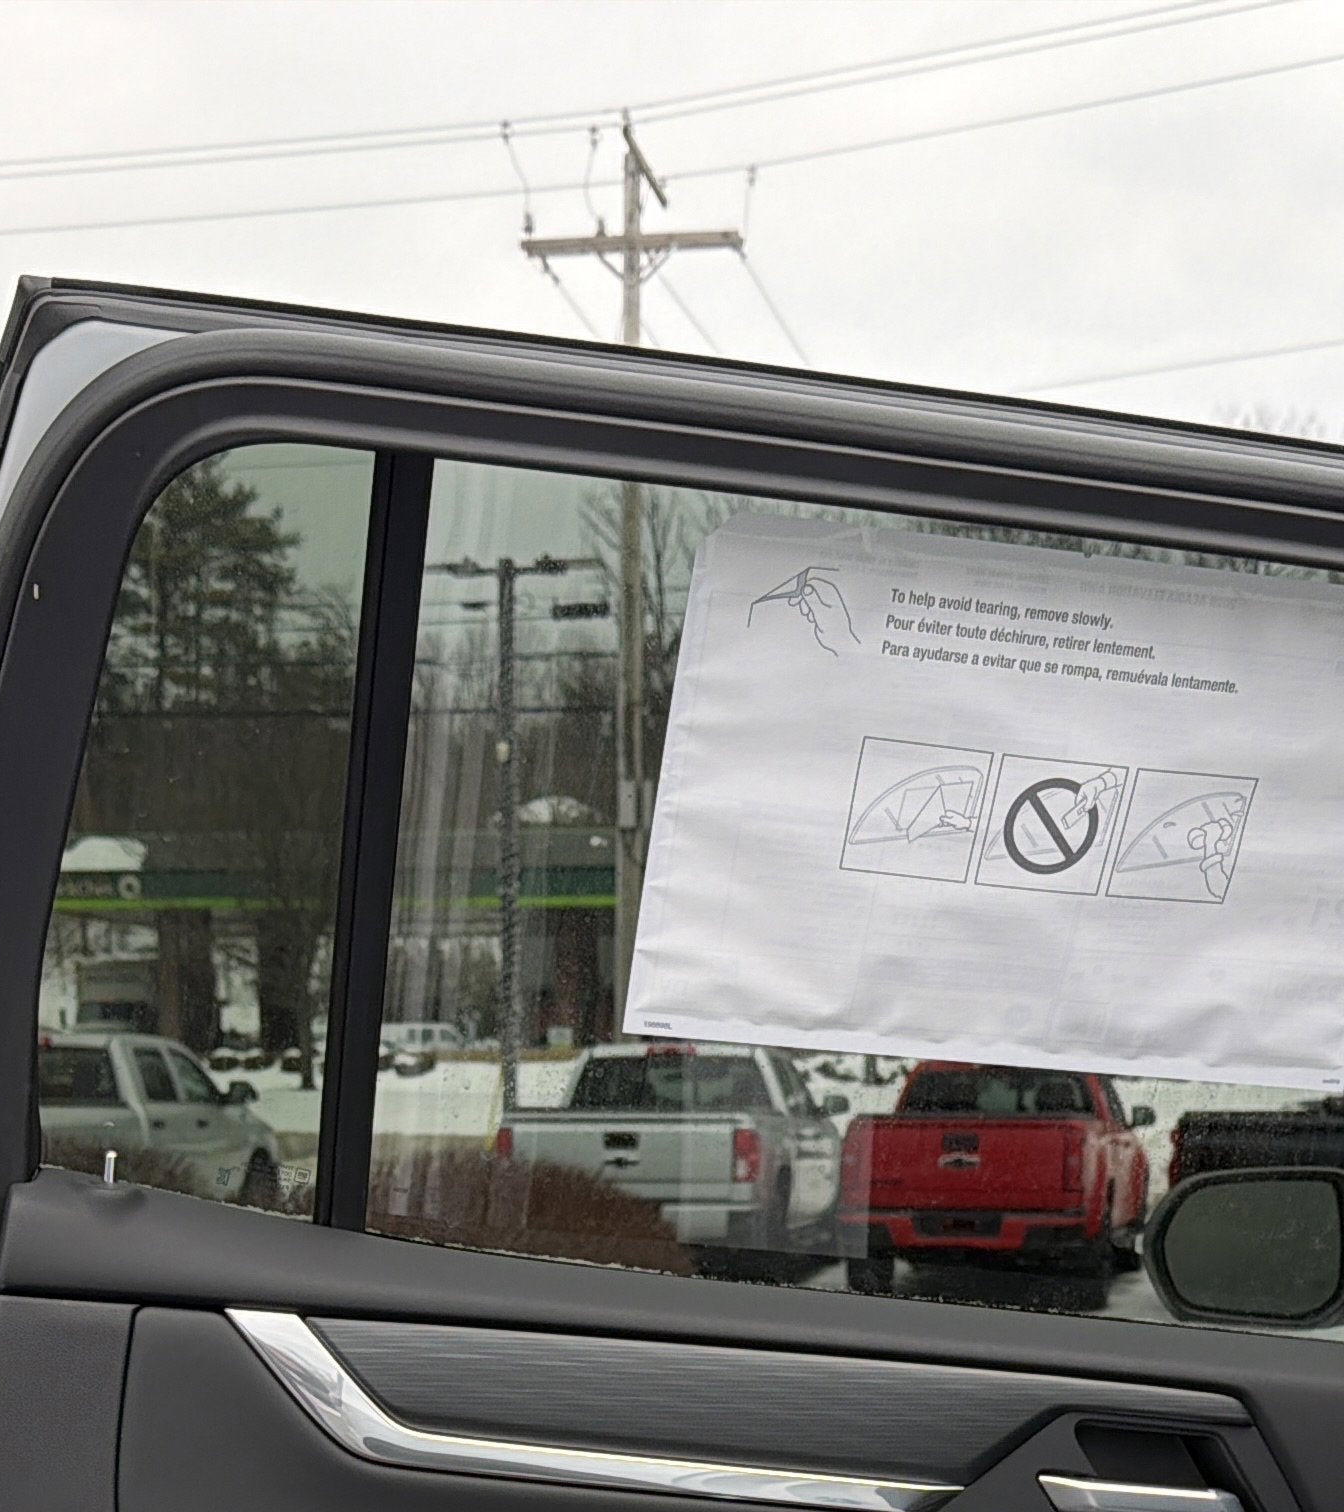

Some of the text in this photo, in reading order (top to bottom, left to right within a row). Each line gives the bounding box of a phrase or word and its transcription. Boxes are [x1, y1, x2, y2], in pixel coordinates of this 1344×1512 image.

[891, 588, 1114, 630] To help avoid tearing, remove slowly.
[885, 614, 1156, 660] Pour éviter toute déchirure, retirer lentement.
[881, 640, 1240, 694] Para ayudarse a evitar que se rompa, remuévala lentamente.
